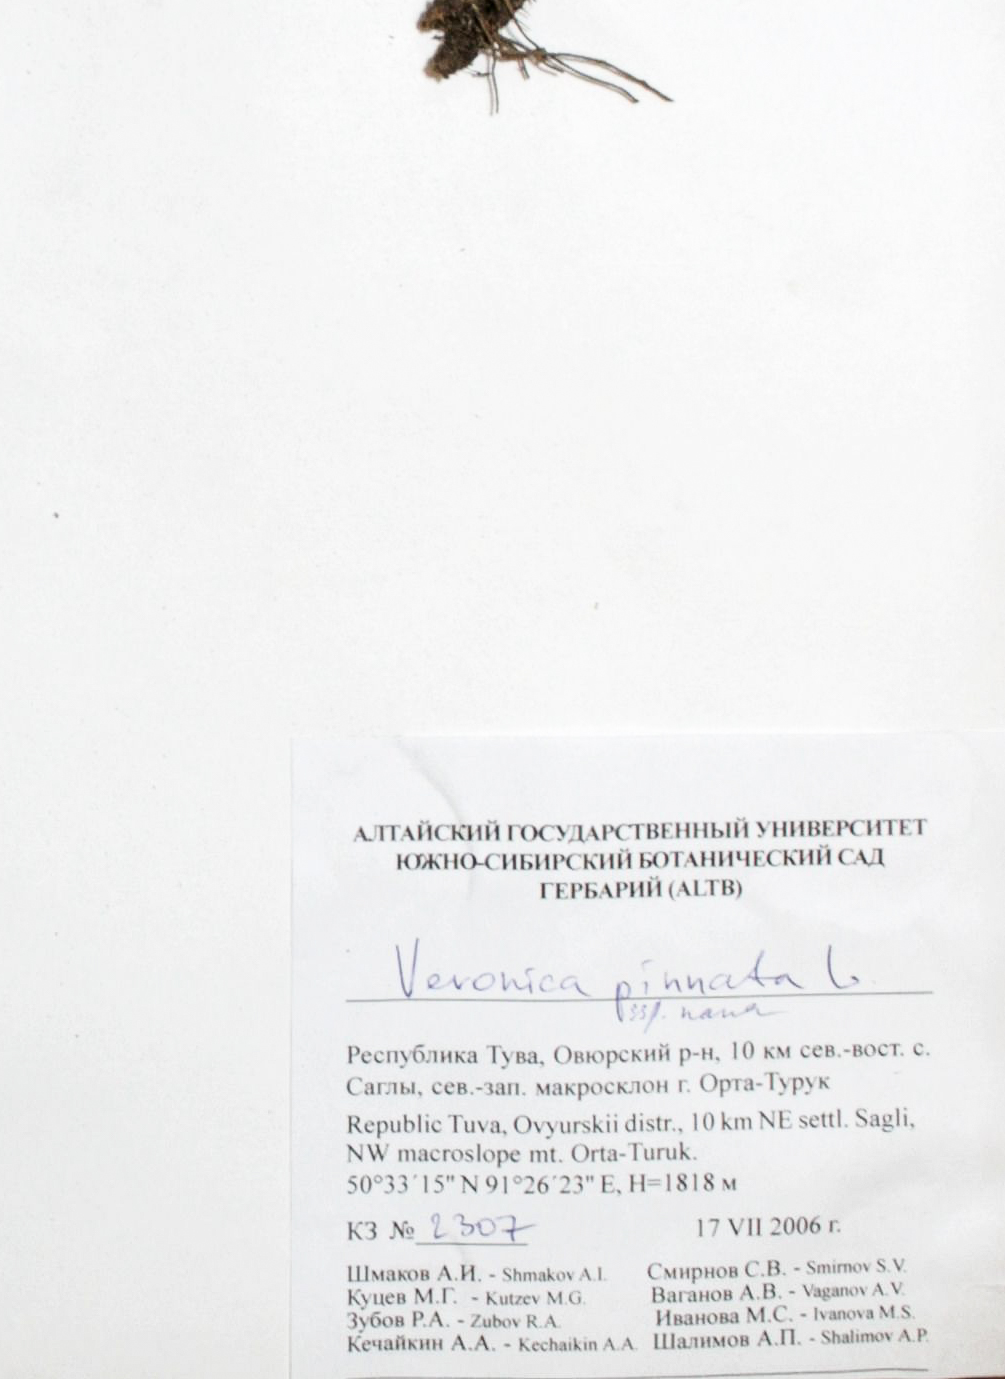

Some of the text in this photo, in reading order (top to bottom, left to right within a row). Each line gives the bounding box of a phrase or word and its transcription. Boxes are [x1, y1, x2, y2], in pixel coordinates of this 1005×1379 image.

[353, 817, 928, 844] АЛТАЙСКИЙ ГОСУДАРСТВЕННЫЙ УНИВЕРСИТЕТ
[396, 844, 885, 871] ЮЖНО-СИБИРСКИЙ БОТАНИЧЕСКИЙ САД
[540, 876, 743, 901] ГЕРБАРИЙ (ALTB)
[396, 938, 594, 999] Veronica
[614, 950, 805, 1024] pinnata
[348, 1040, 930, 1070] Республика Тува, Овюрский р-н, 10 км сев.-вост. с.
[346, 1072, 830, 1101] Саглы, сев.-зап. макросклон г. Орта-Турук
[347, 1107, 915, 1140] Republic Tuva, Ovyurskii distr., 10 km NE settl. Sagli,
[346, 1141, 697, 1168] NW macroslope mt. Orta-Turuk.
[460, 1175, 478, 1194] N
[601, 1174, 622, 1196] E,
[629, 1172, 714, 1193] H=1818
[347, 1220, 415, 1241] КЗ №
[431, 1212, 536, 1242] 2307
[698, 1215, 841, 1237] 17 VII 2006 г.
[348, 1265, 430, 1283] Шмаков
[437, 1264, 481, 1282] А.И.
[503, 1268, 574, 1282] Shmakov
[579, 1266, 607, 1281] A.I.
[647, 1262, 739, 1284] Смирнов
[745, 1260, 786, 1278] С.В.
[806, 1260, 871, 1275] Smirnov
[876, 1258, 907, 1273] S.V.
[347, 1289, 407, 1310] Куцев
[415, 1287, 457, 1305] М.Г.
[486, 1291, 540, 1306] Kutzev
[547, 1291, 586, 1305] M.G.
[652, 1286, 733, 1304] Ваганов
[740, 1283, 782, 1301] А.В.
[802, 1284, 868, 1302] Vaganov
[872, 1281, 905, 1296] A.V.
[347, 1311, 405, 1332] Зубов
[412, 1311, 449, 1327] Р.А.
[470, 1314, 521, 1328] Zubov
[526, 1314, 561, 1328] R.A.
[656, 1309, 739, 1326] Иванова
[746, 1305, 793, 1323] М.С.
[814, 1307, 874, 1321] Ivanova
[879, 1305, 915, 1319] M.S.
[348, 1332, 443, 1353] Кечайкин
[451, 1334, 495, 1351] А.А.
[519, 1337, 598, 1352] Kechaikin
[603, 1337, 637, 1351] A.A.
[654, 1333, 750, 1350] Шалимов
[757, 1328, 801, 1347] А.П.
[821, 1329, 893, 1345] Shalimov
[898, 1328, 929, 1342] A.P.
